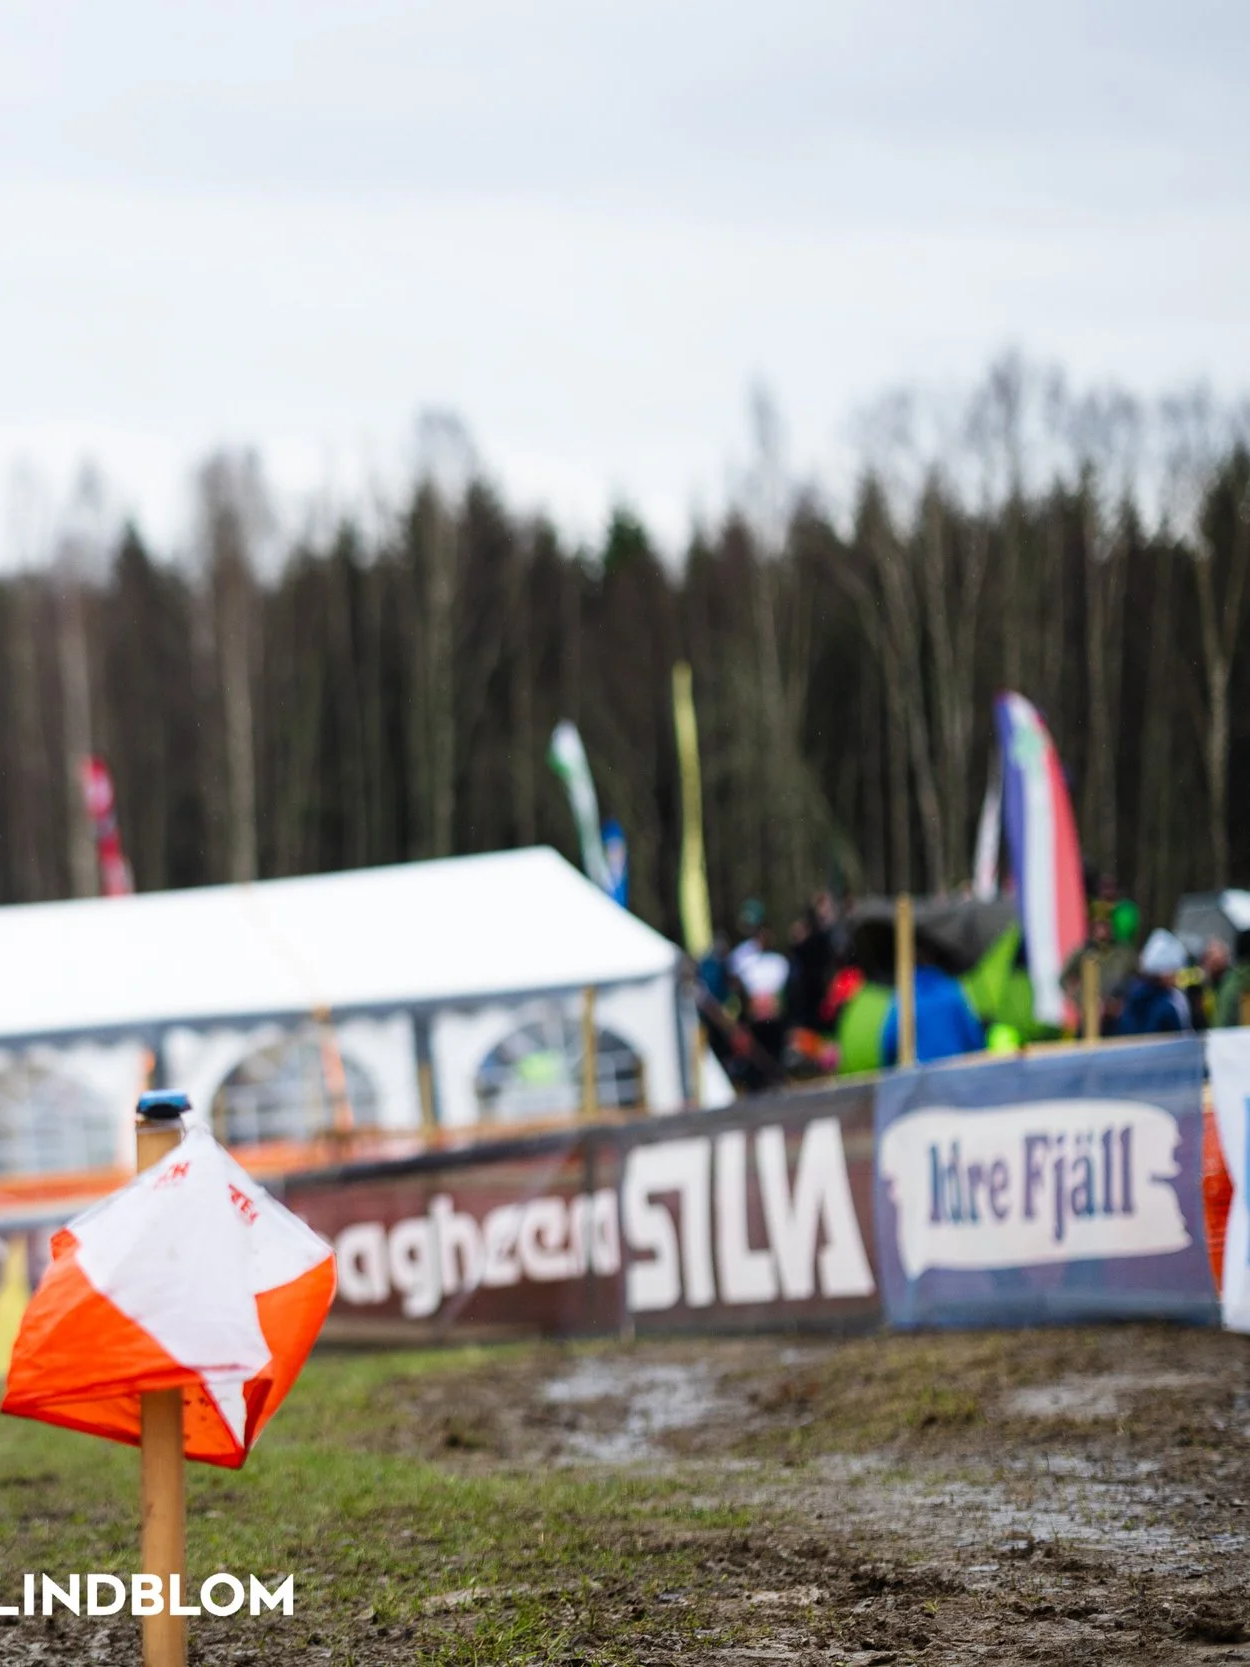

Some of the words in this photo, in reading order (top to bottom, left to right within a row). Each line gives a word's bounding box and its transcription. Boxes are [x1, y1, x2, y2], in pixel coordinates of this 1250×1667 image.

[624, 1116, 876, 1313] SILVA
[928, 1137, 1011, 1225] Idre
[1020, 1122, 1136, 1244] Fjäll
[334, 1189, 622, 1319] agheera
